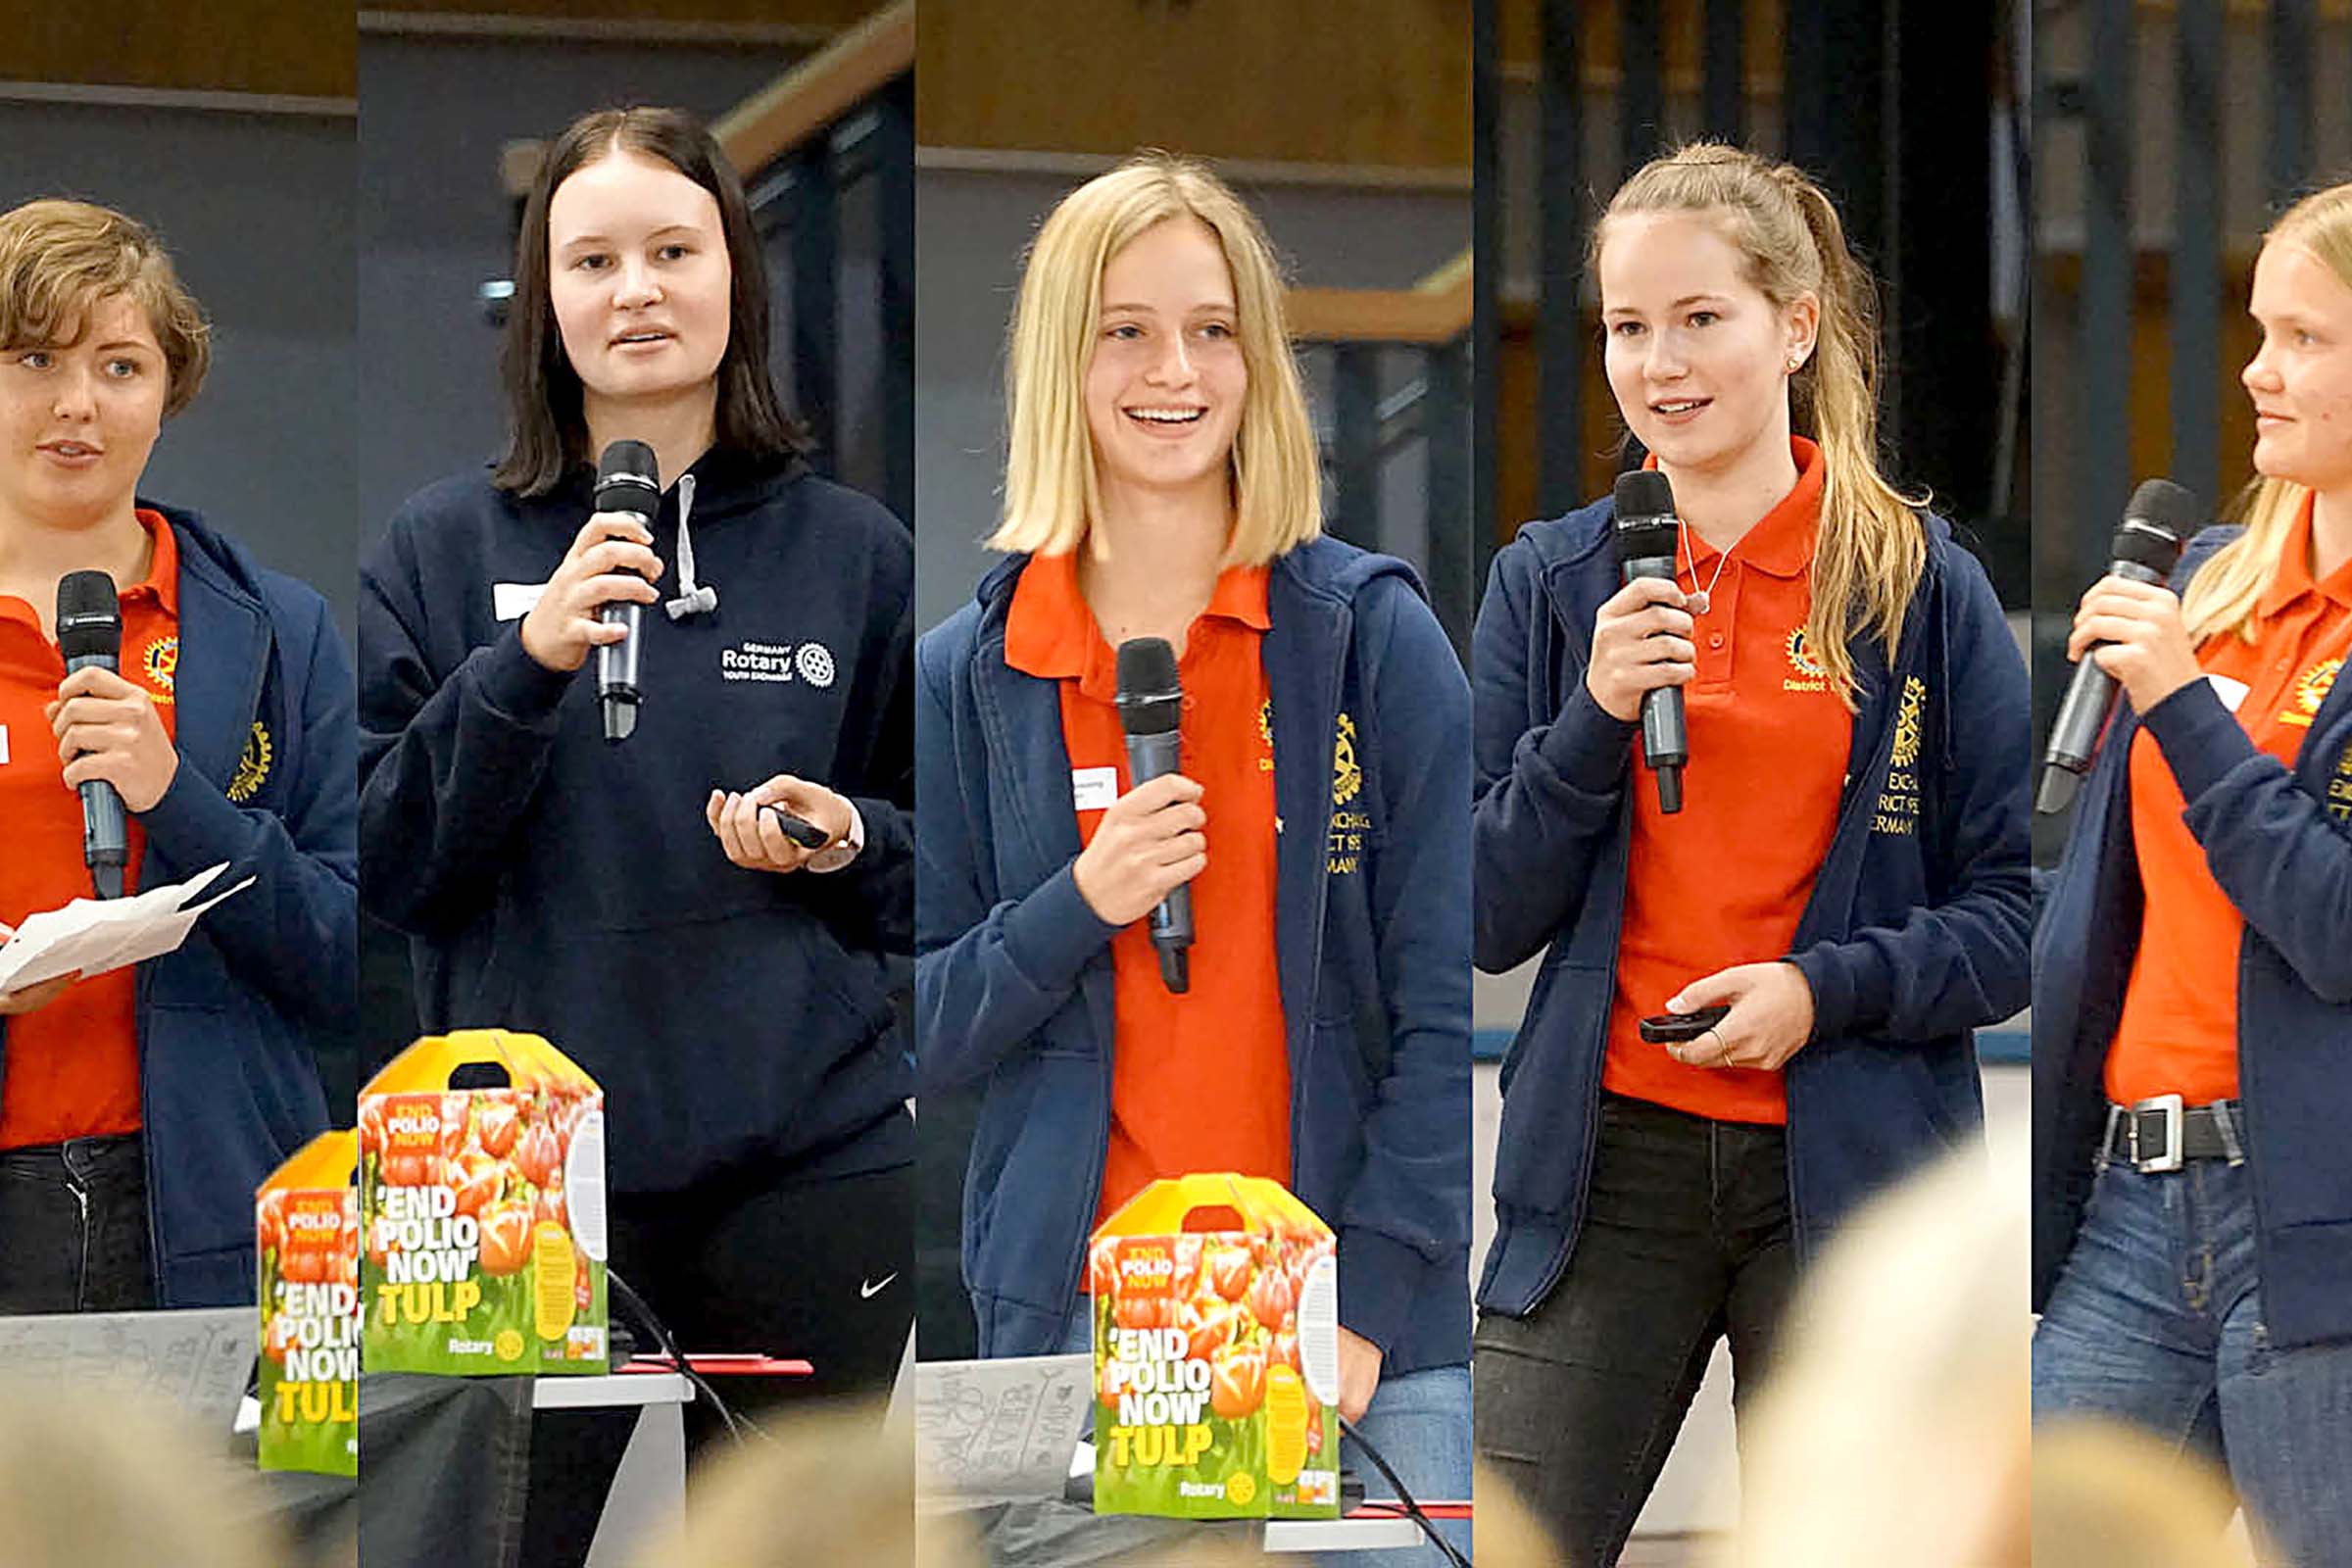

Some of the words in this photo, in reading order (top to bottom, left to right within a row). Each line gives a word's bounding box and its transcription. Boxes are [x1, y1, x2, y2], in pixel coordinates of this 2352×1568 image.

[722, 650, 791, 673] Rotary
[388, 1116, 440, 1135] POLIO
[288, 1211, 341, 1230] POLIO
[375, 1216, 479, 1251] POLIO
[1120, 1259, 1173, 1276] POLIO
[377, 1282, 481, 1325] TULP
[275, 1314, 359, 1349] POLI
[448, 1338, 493, 1355] Rotary
[285, 1348, 359, 1382] NOW
[1108, 1358, 1212, 1394] POLIO
[275, 1381, 359, 1423] TUL
[1109, 1425, 1213, 1467] TULP
[1180, 1481, 1225, 1499] Rotary
